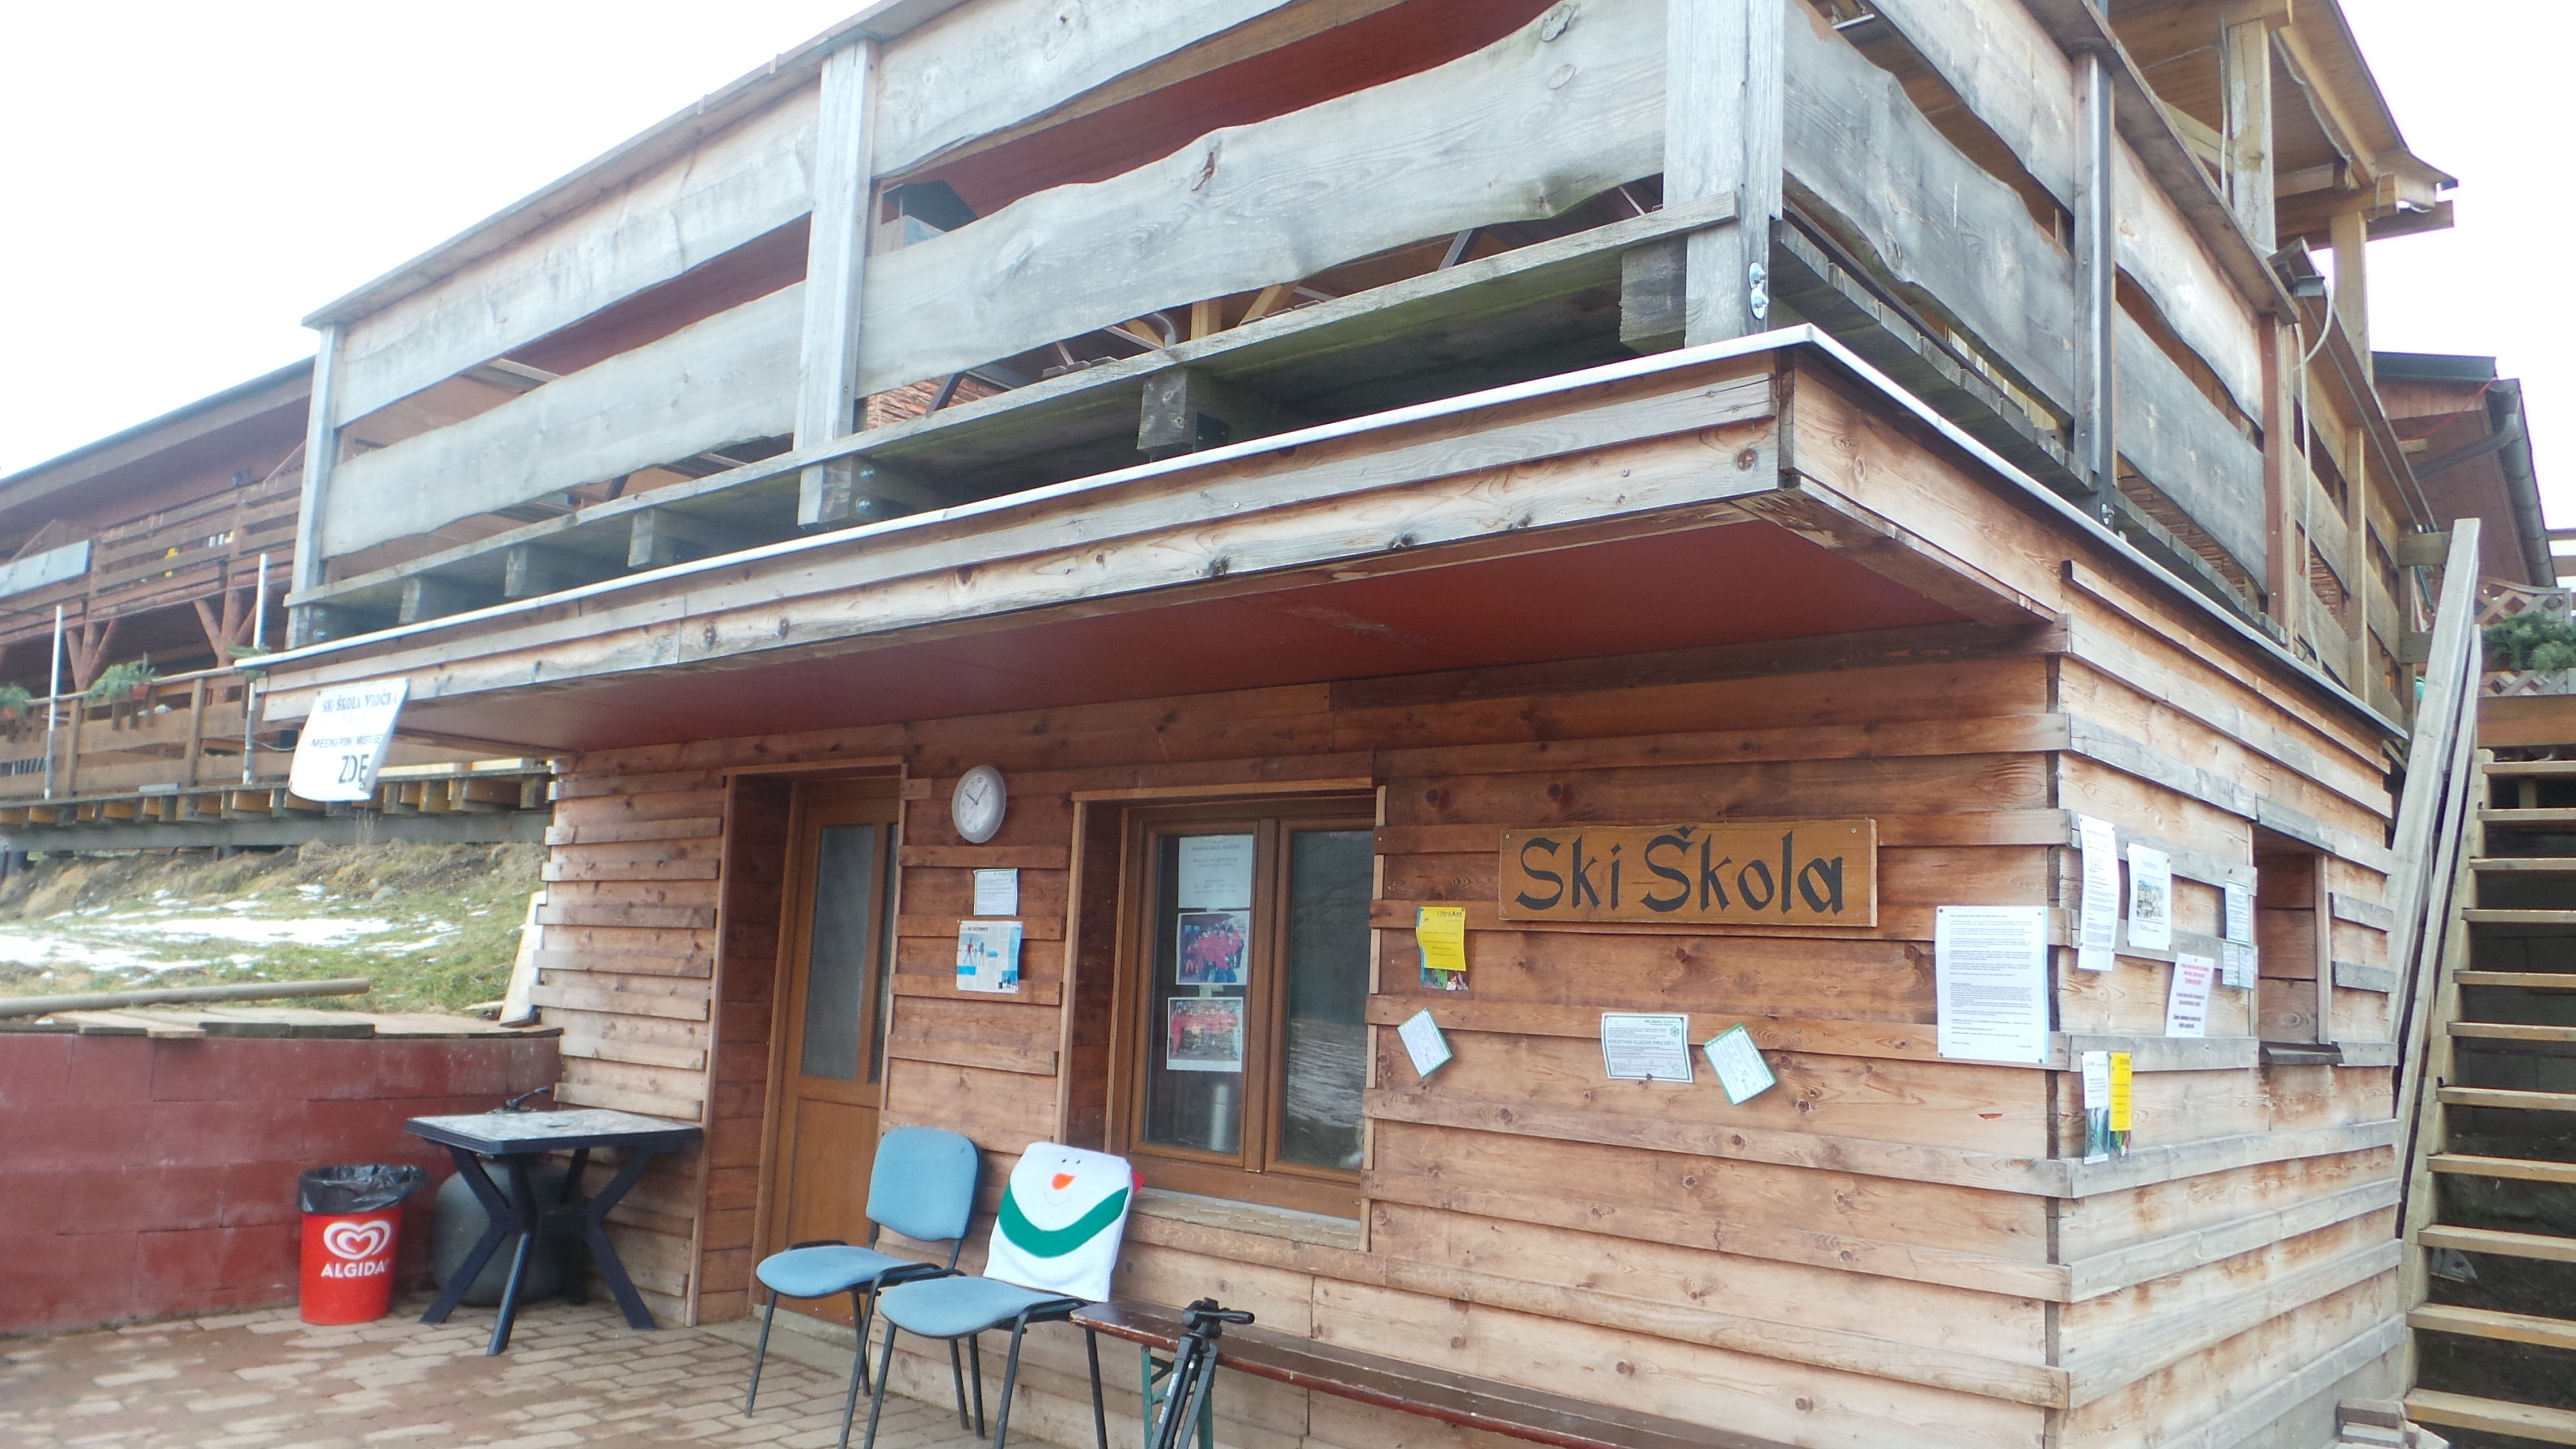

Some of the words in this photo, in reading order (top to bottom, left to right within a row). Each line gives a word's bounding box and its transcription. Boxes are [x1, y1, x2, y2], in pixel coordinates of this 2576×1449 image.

[338, 753, 369, 784] ZDE
[1515, 834, 1623, 911] Ski
[1640, 826, 1844, 915] Škola
[321, 1260, 384, 1278] ALGIDA
